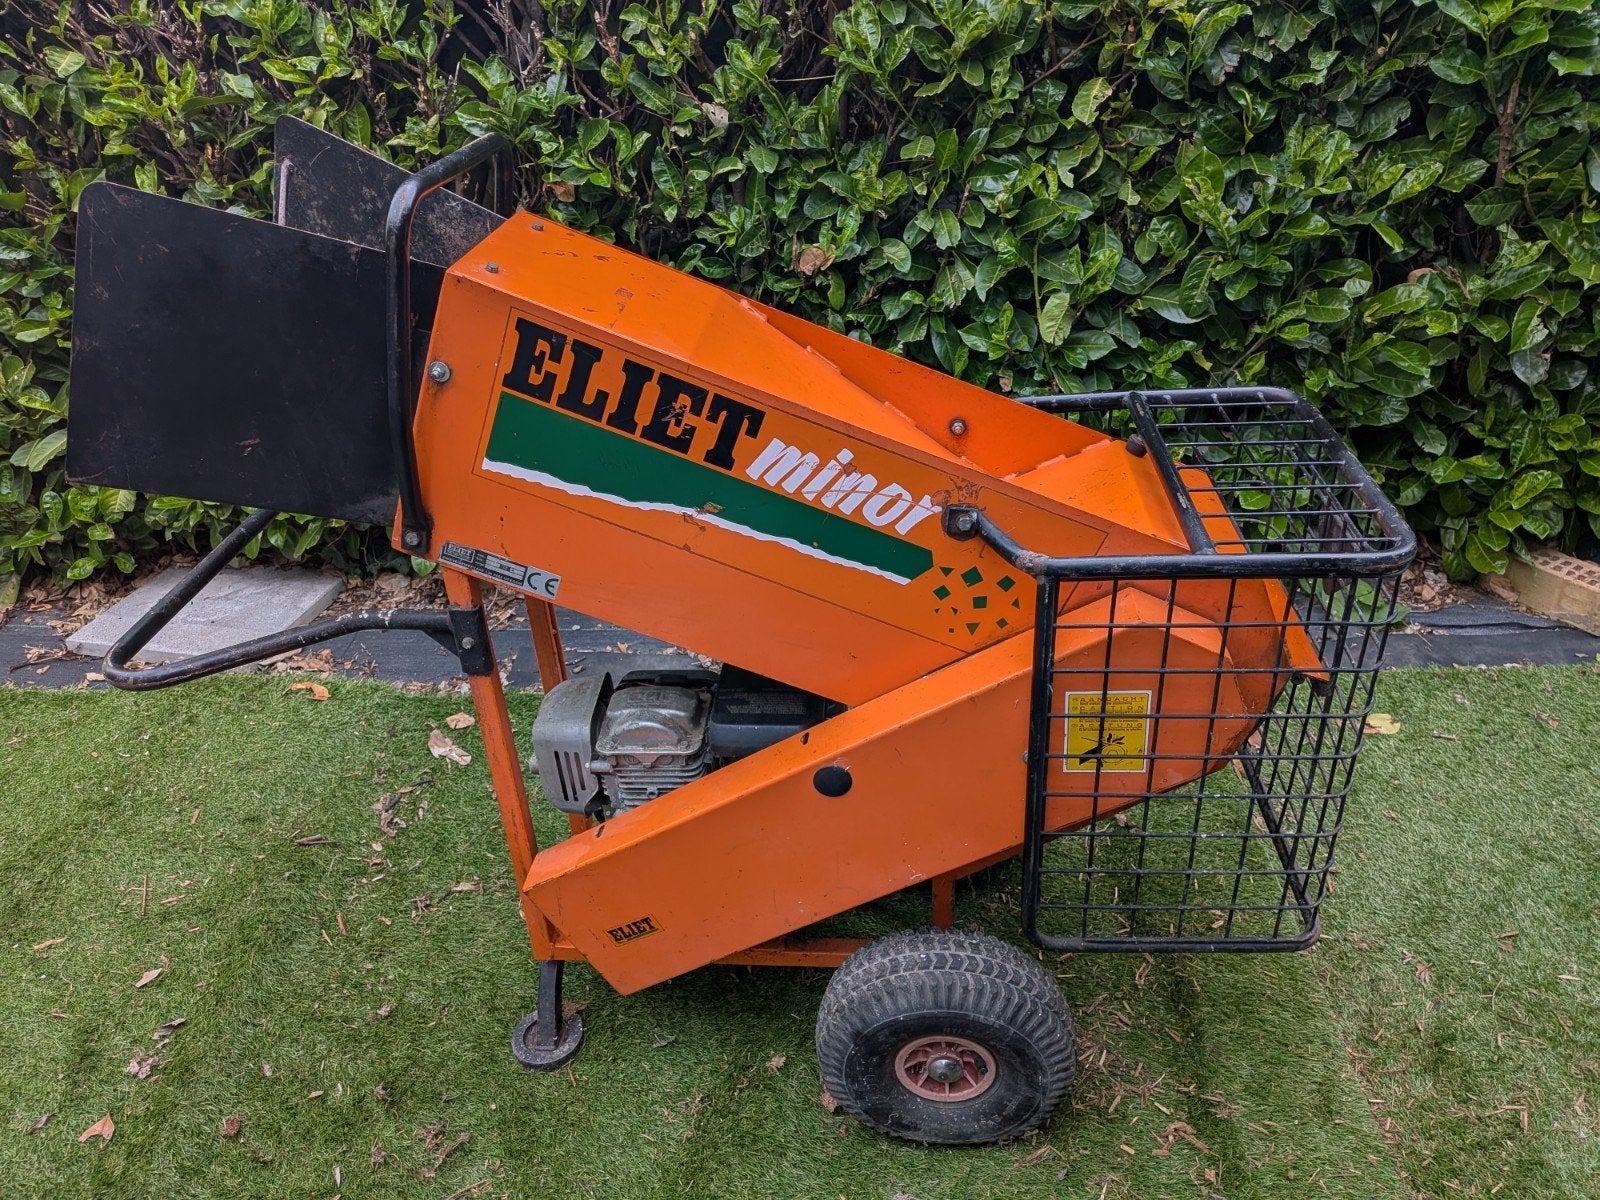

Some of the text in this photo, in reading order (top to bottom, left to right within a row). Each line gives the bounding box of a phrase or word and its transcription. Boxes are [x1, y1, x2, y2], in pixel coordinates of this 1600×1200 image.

[502, 316, 943, 536] ELIET minor
[527, 572, 559, 596] CE
[607, 916, 656, 942] ELIET
